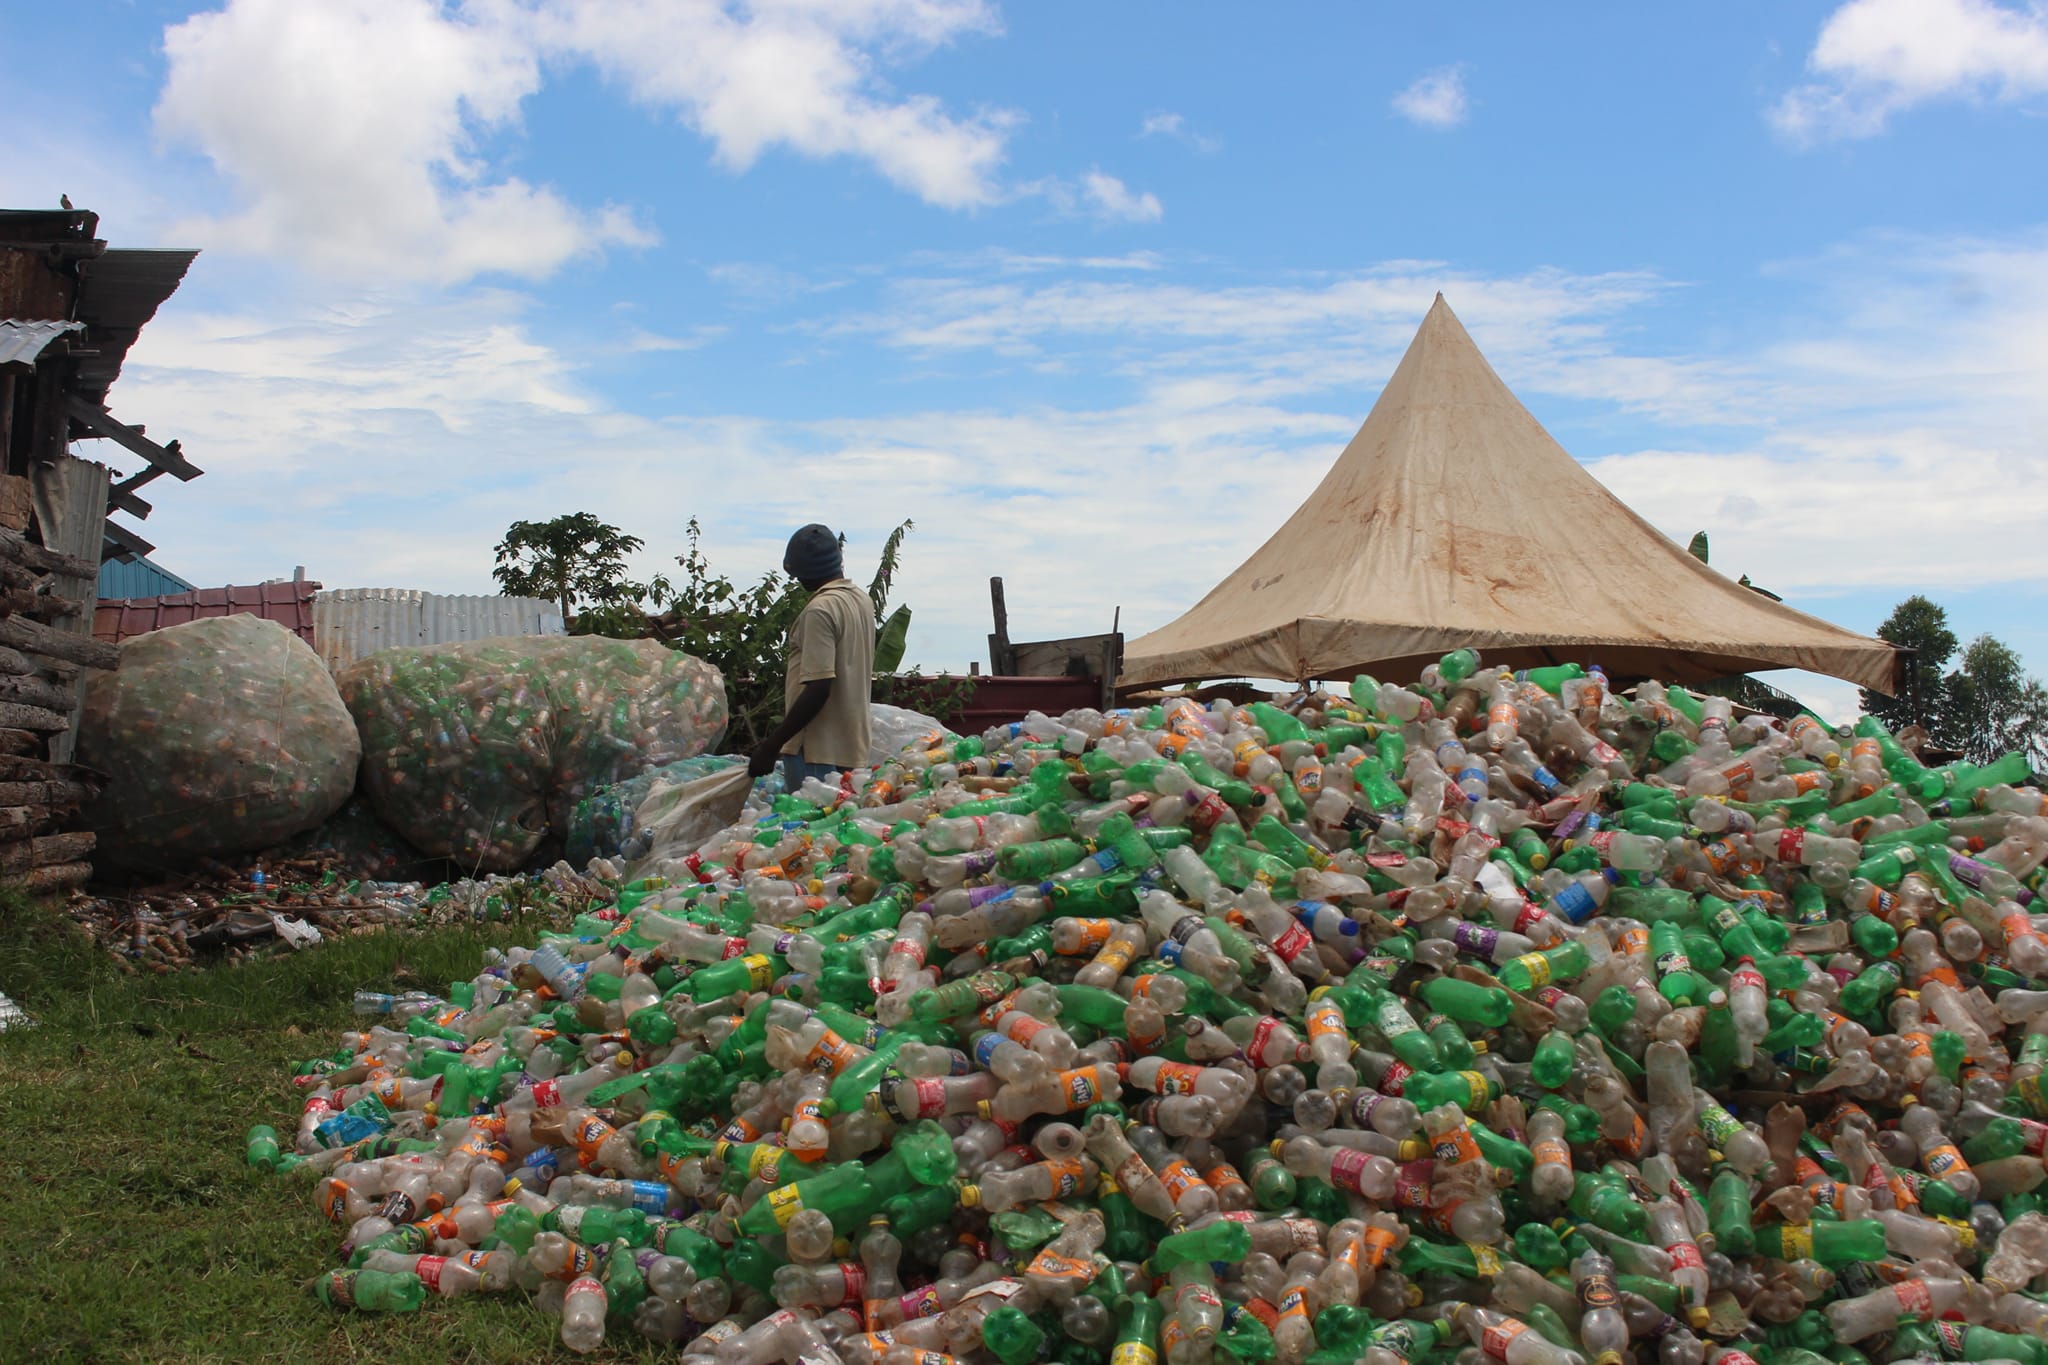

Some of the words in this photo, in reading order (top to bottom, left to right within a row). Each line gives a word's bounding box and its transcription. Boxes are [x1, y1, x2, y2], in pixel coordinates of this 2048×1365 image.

[1072, 1075, 1091, 1104] FANTA
[803, 1104, 821, 1118] FAN
[1927, 1153, 1955, 1174] FANTA
